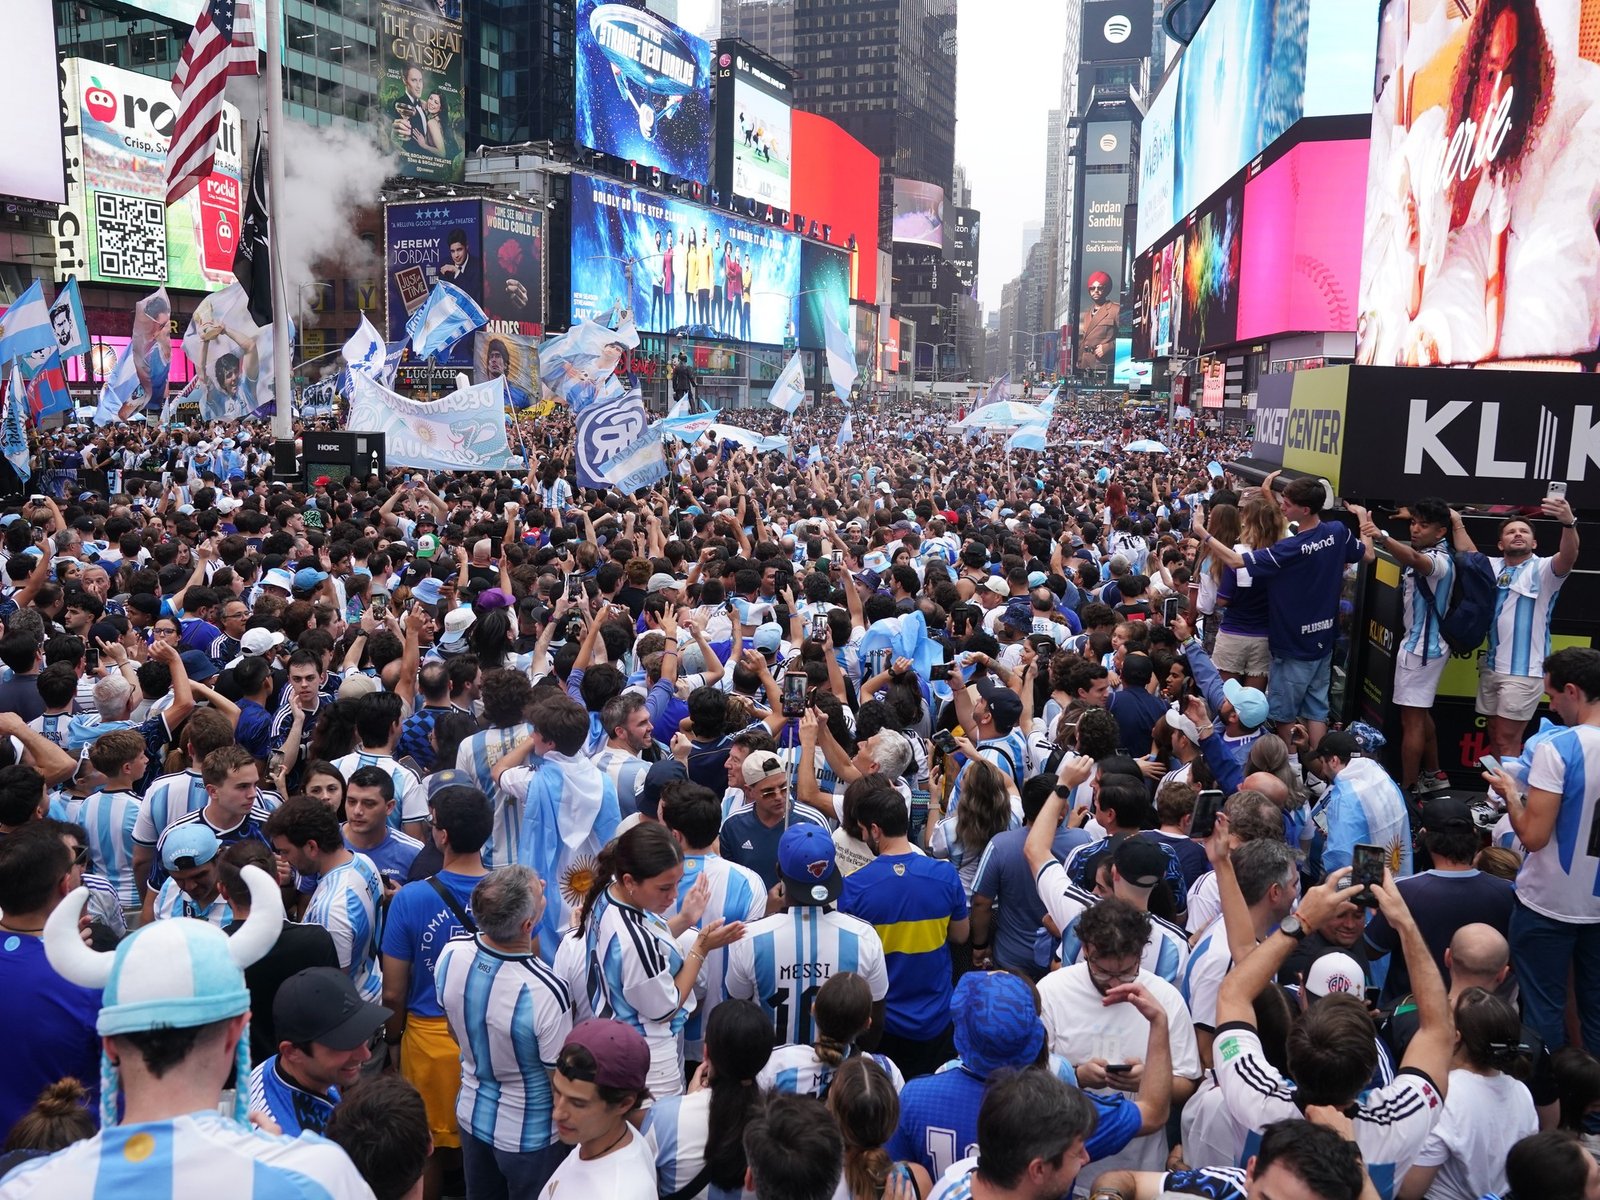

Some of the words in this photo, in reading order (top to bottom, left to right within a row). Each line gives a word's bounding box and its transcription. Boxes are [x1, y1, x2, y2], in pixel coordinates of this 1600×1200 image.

[382, 13, 409, 39] THE
[413, 23, 463, 53] GREAT
[392, 38, 454, 70] GATSBY
[720, 69, 730, 77] LG
[743, 61, 749, 72] LG
[124, 136, 154, 153] Crisp,
[207, 179, 236, 199] rockit
[593, 190, 620, 208] BOLDLY
[621, 198, 630, 211] GO
[648, 205, 663, 219] STEP
[1089, 200, 1121, 213] Jordan
[507, 209, 515, 219] SEE
[525, 212, 533, 223] THE
[1088, 214, 1122, 228] Sandhu
[487, 215, 509, 232] WORLD
[511, 221, 531, 235] COULD
[394, 239, 440, 249] JEREMY
[1085, 244, 1101, 252] God's
[1101, 244, 1123, 252] Favorite
[394, 249, 440, 264] JORDAN
[402, 272, 417, 289] JUST
[408, 281, 427, 299] TIME
[406, 370, 457, 379] LUGGAGE
[1255, 407, 1288, 446] TICKET
[1288, 408, 1341, 456] CENTER
[780, 964, 830, 980] MESSI
